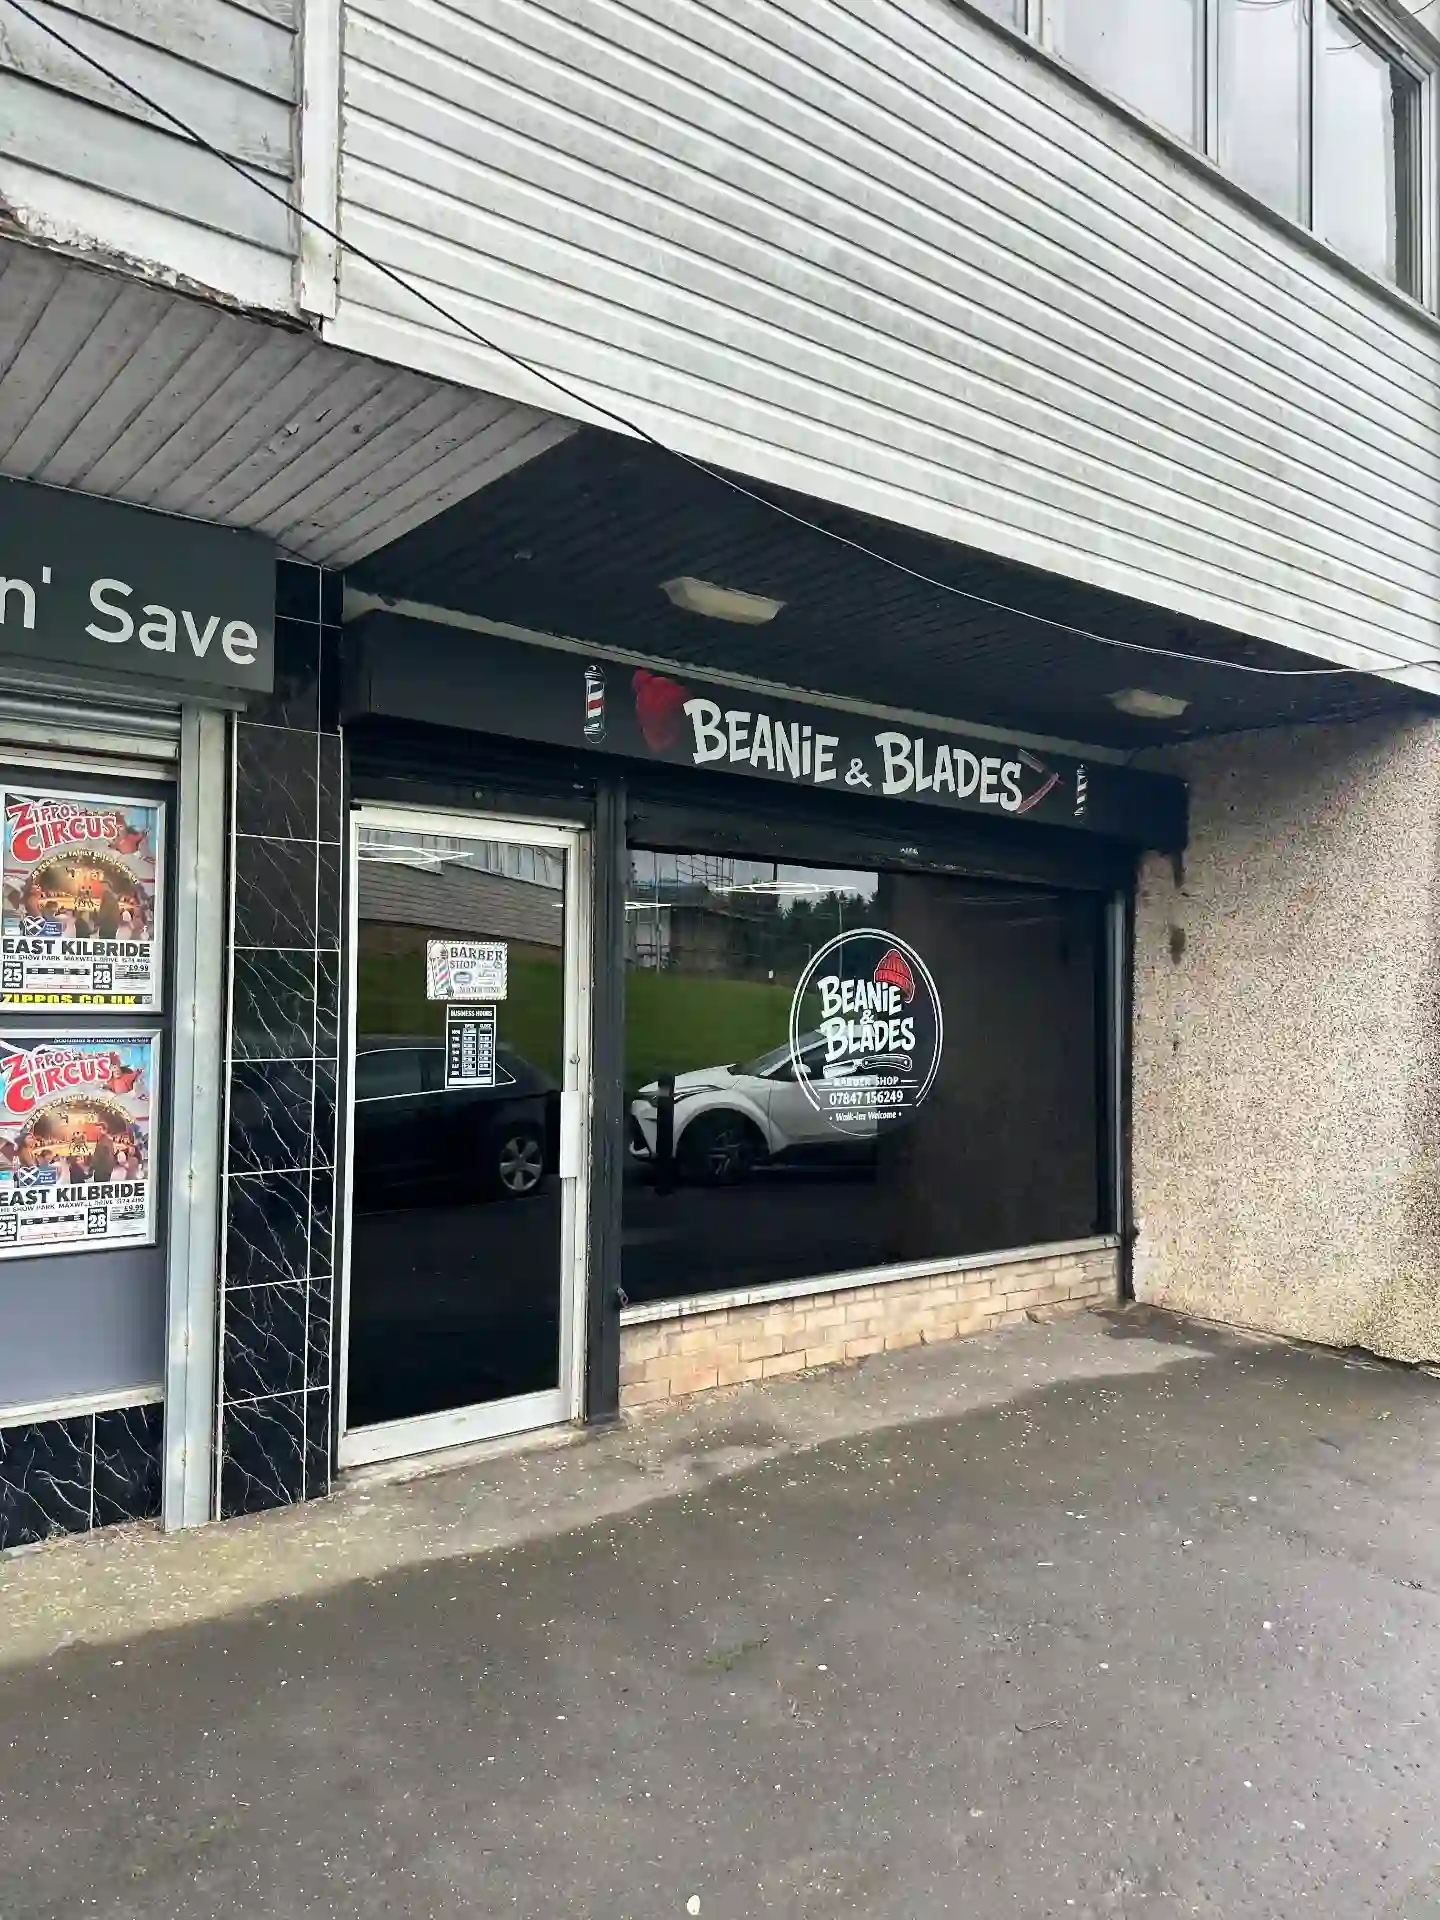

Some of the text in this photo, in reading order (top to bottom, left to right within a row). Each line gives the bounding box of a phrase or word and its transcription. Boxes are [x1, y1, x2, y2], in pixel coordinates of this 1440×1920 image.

[85, 578, 258, 665] Save
[845, 758, 872, 788] &
[875, 731, 1022, 812] BLADES
[6, 801, 78, 832] ZIPPOS
[11, 815, 118, 863] CIRCUS
[2, 939, 150, 957] EAST KILBRIDE
[450, 947, 503, 961] BARBER
[450, 960, 476, 969] SHOP
[3, 968, 23, 982] 25
[93, 970, 112, 984] 28
[2, 993, 136, 1004] ZIPPOSCOUK
[860, 1010, 875, 1023] &
[820, 1016, 916, 1062] BLADES
[1, 1050, 73, 1081] ZIPPOS
[5, 1058, 112, 1114] CIRCUS
[875, 1076, 899, 1086] SHOP
[829, 1090, 904, 1106] 07847 156249
[868, 1110, 897, 1120] Welcome
[0, 1182, 145, 1207] EAST KILBRIDE
[123, 1204, 144, 1212] £9.99
[0, 1221, 17, 1235] 25
[88, 1214, 107, 1228] 28
